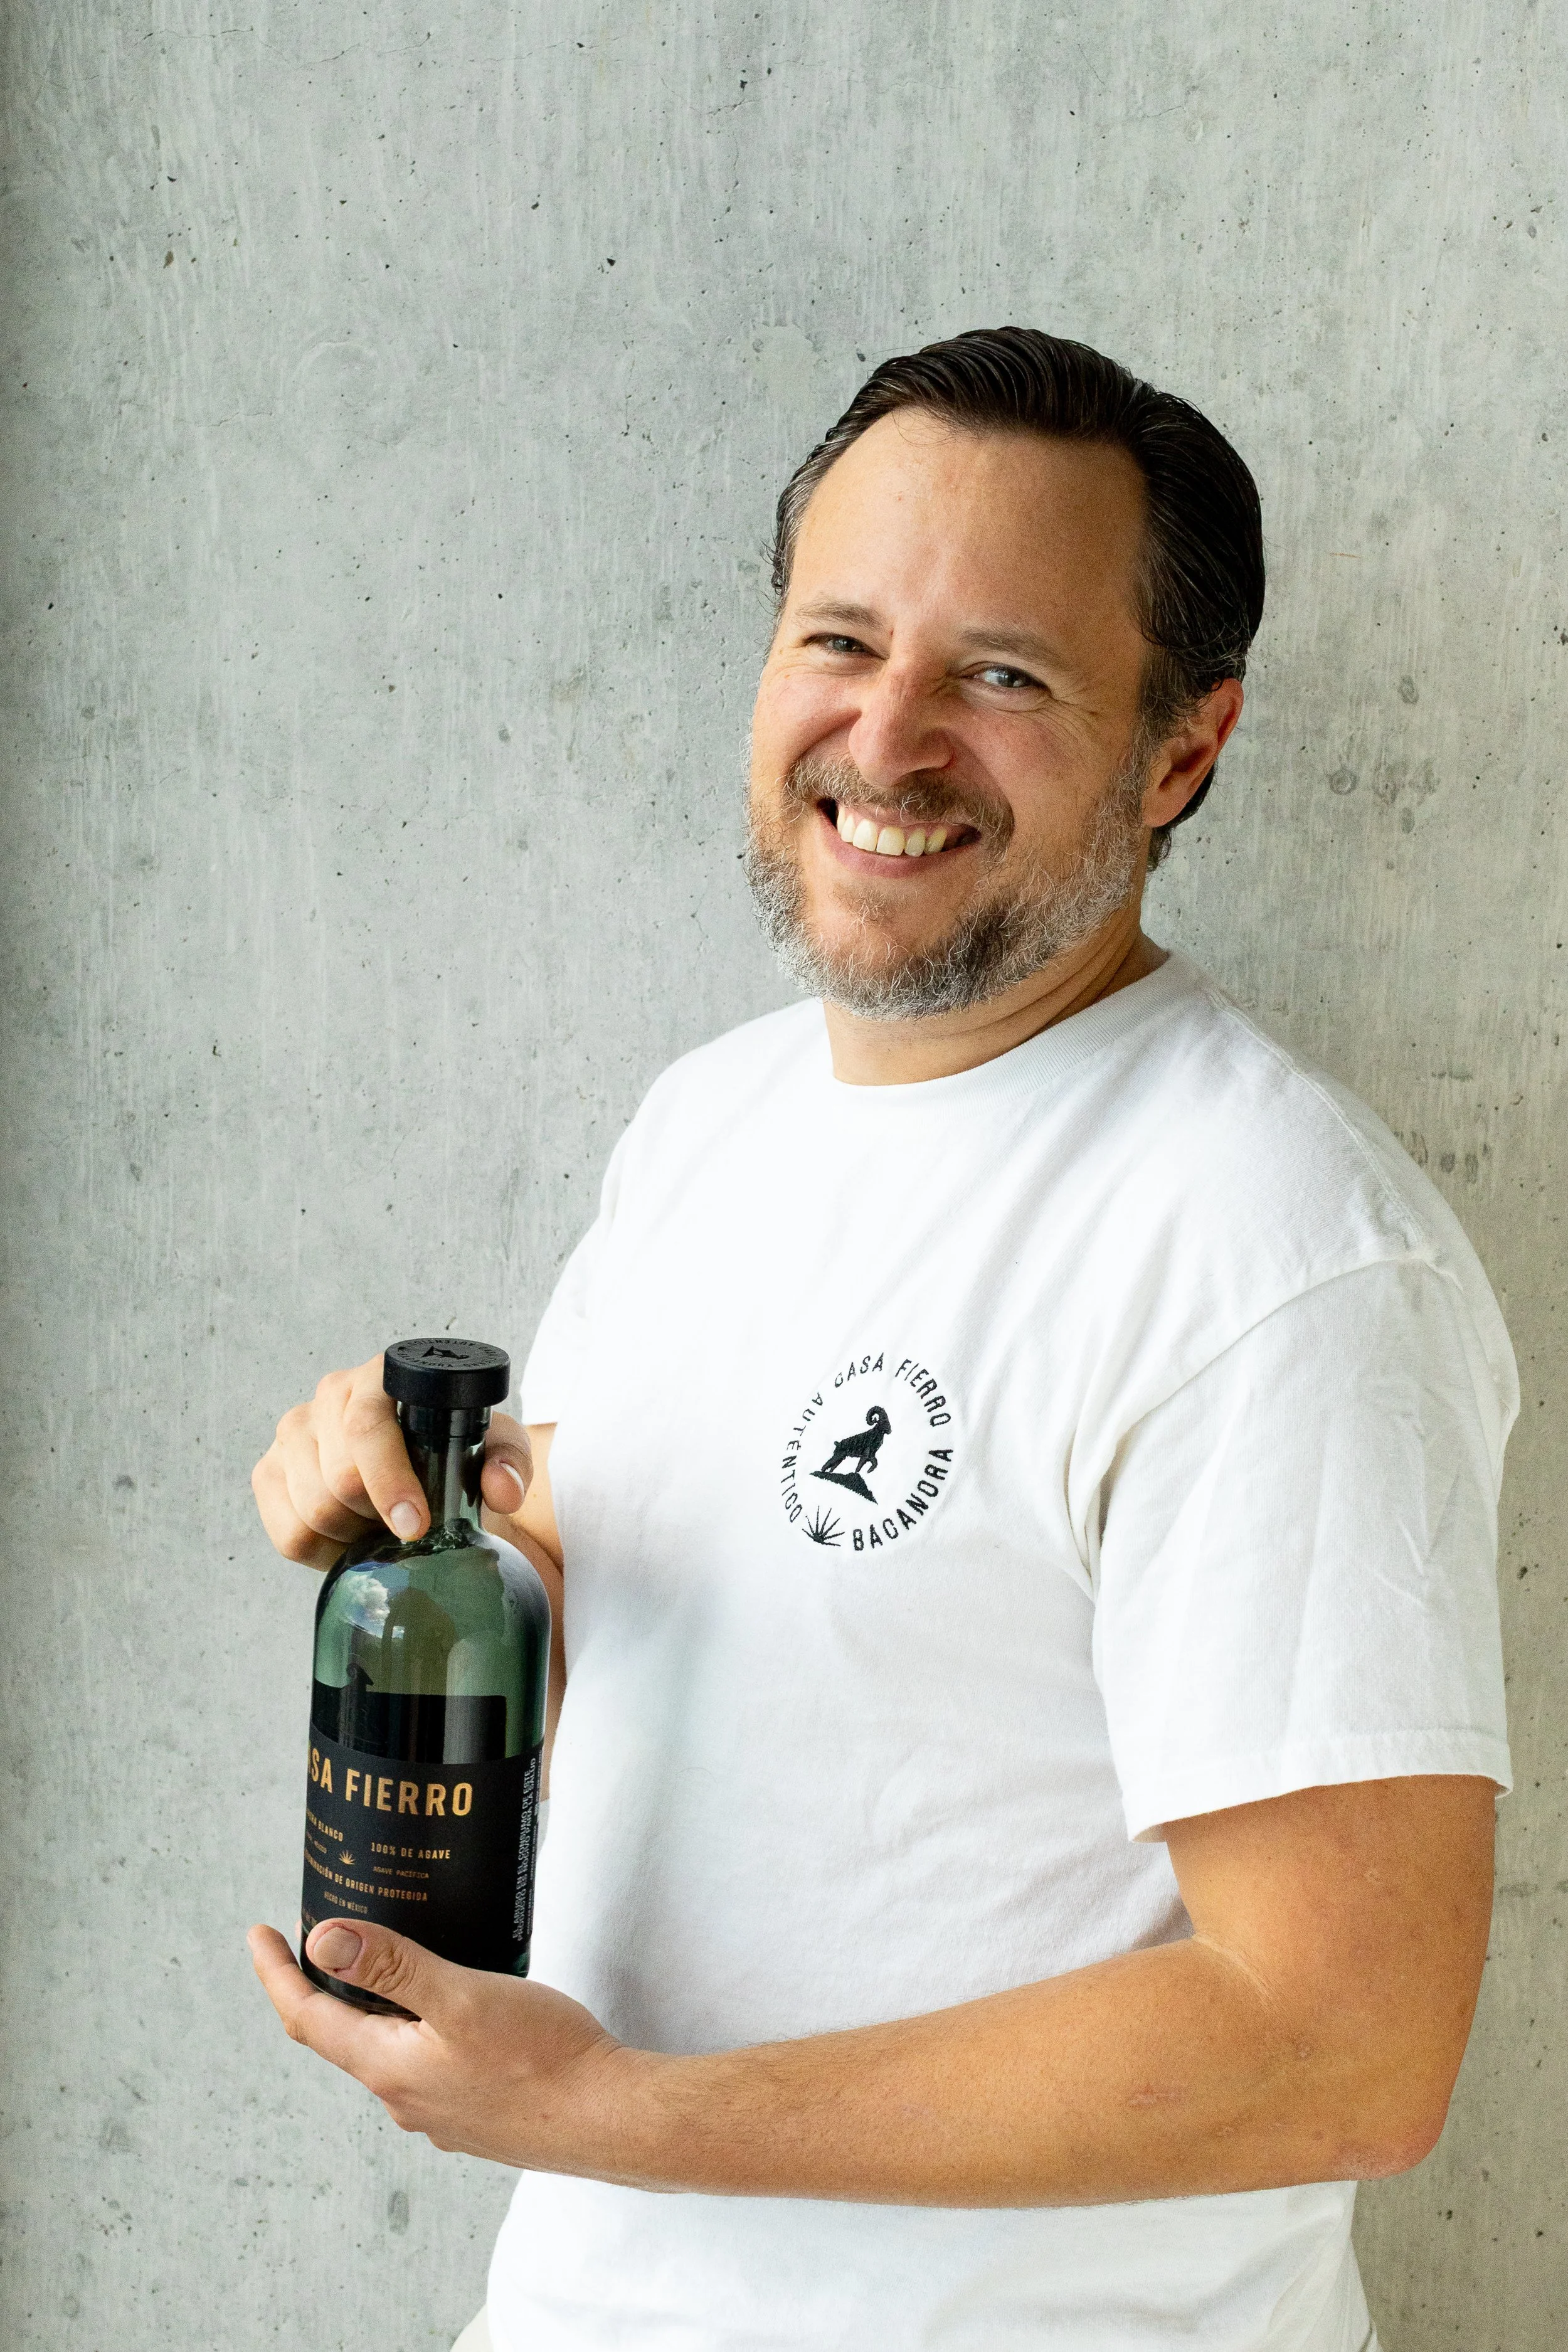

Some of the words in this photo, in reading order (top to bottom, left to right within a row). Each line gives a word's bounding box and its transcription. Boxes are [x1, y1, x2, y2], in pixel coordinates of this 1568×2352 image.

[834, 1352, 884, 1388] CASA
[895, 1359, 951, 1428] FIERRO
[852, 1448, 954, 1551] BACANORA
[345, 1767, 473, 1816] FIERRO
[318, 1820, 344, 1842] BLANCO
[371, 1841, 396, 1856] 100%
[401, 1847, 413, 1857] DE
[418, 1849, 451, 1860] AGAVE
[334, 1873, 344, 1885] DE
[345, 1878, 374, 1895] ORIGEN
[378, 1886, 428, 1902] PROTEGIDA
